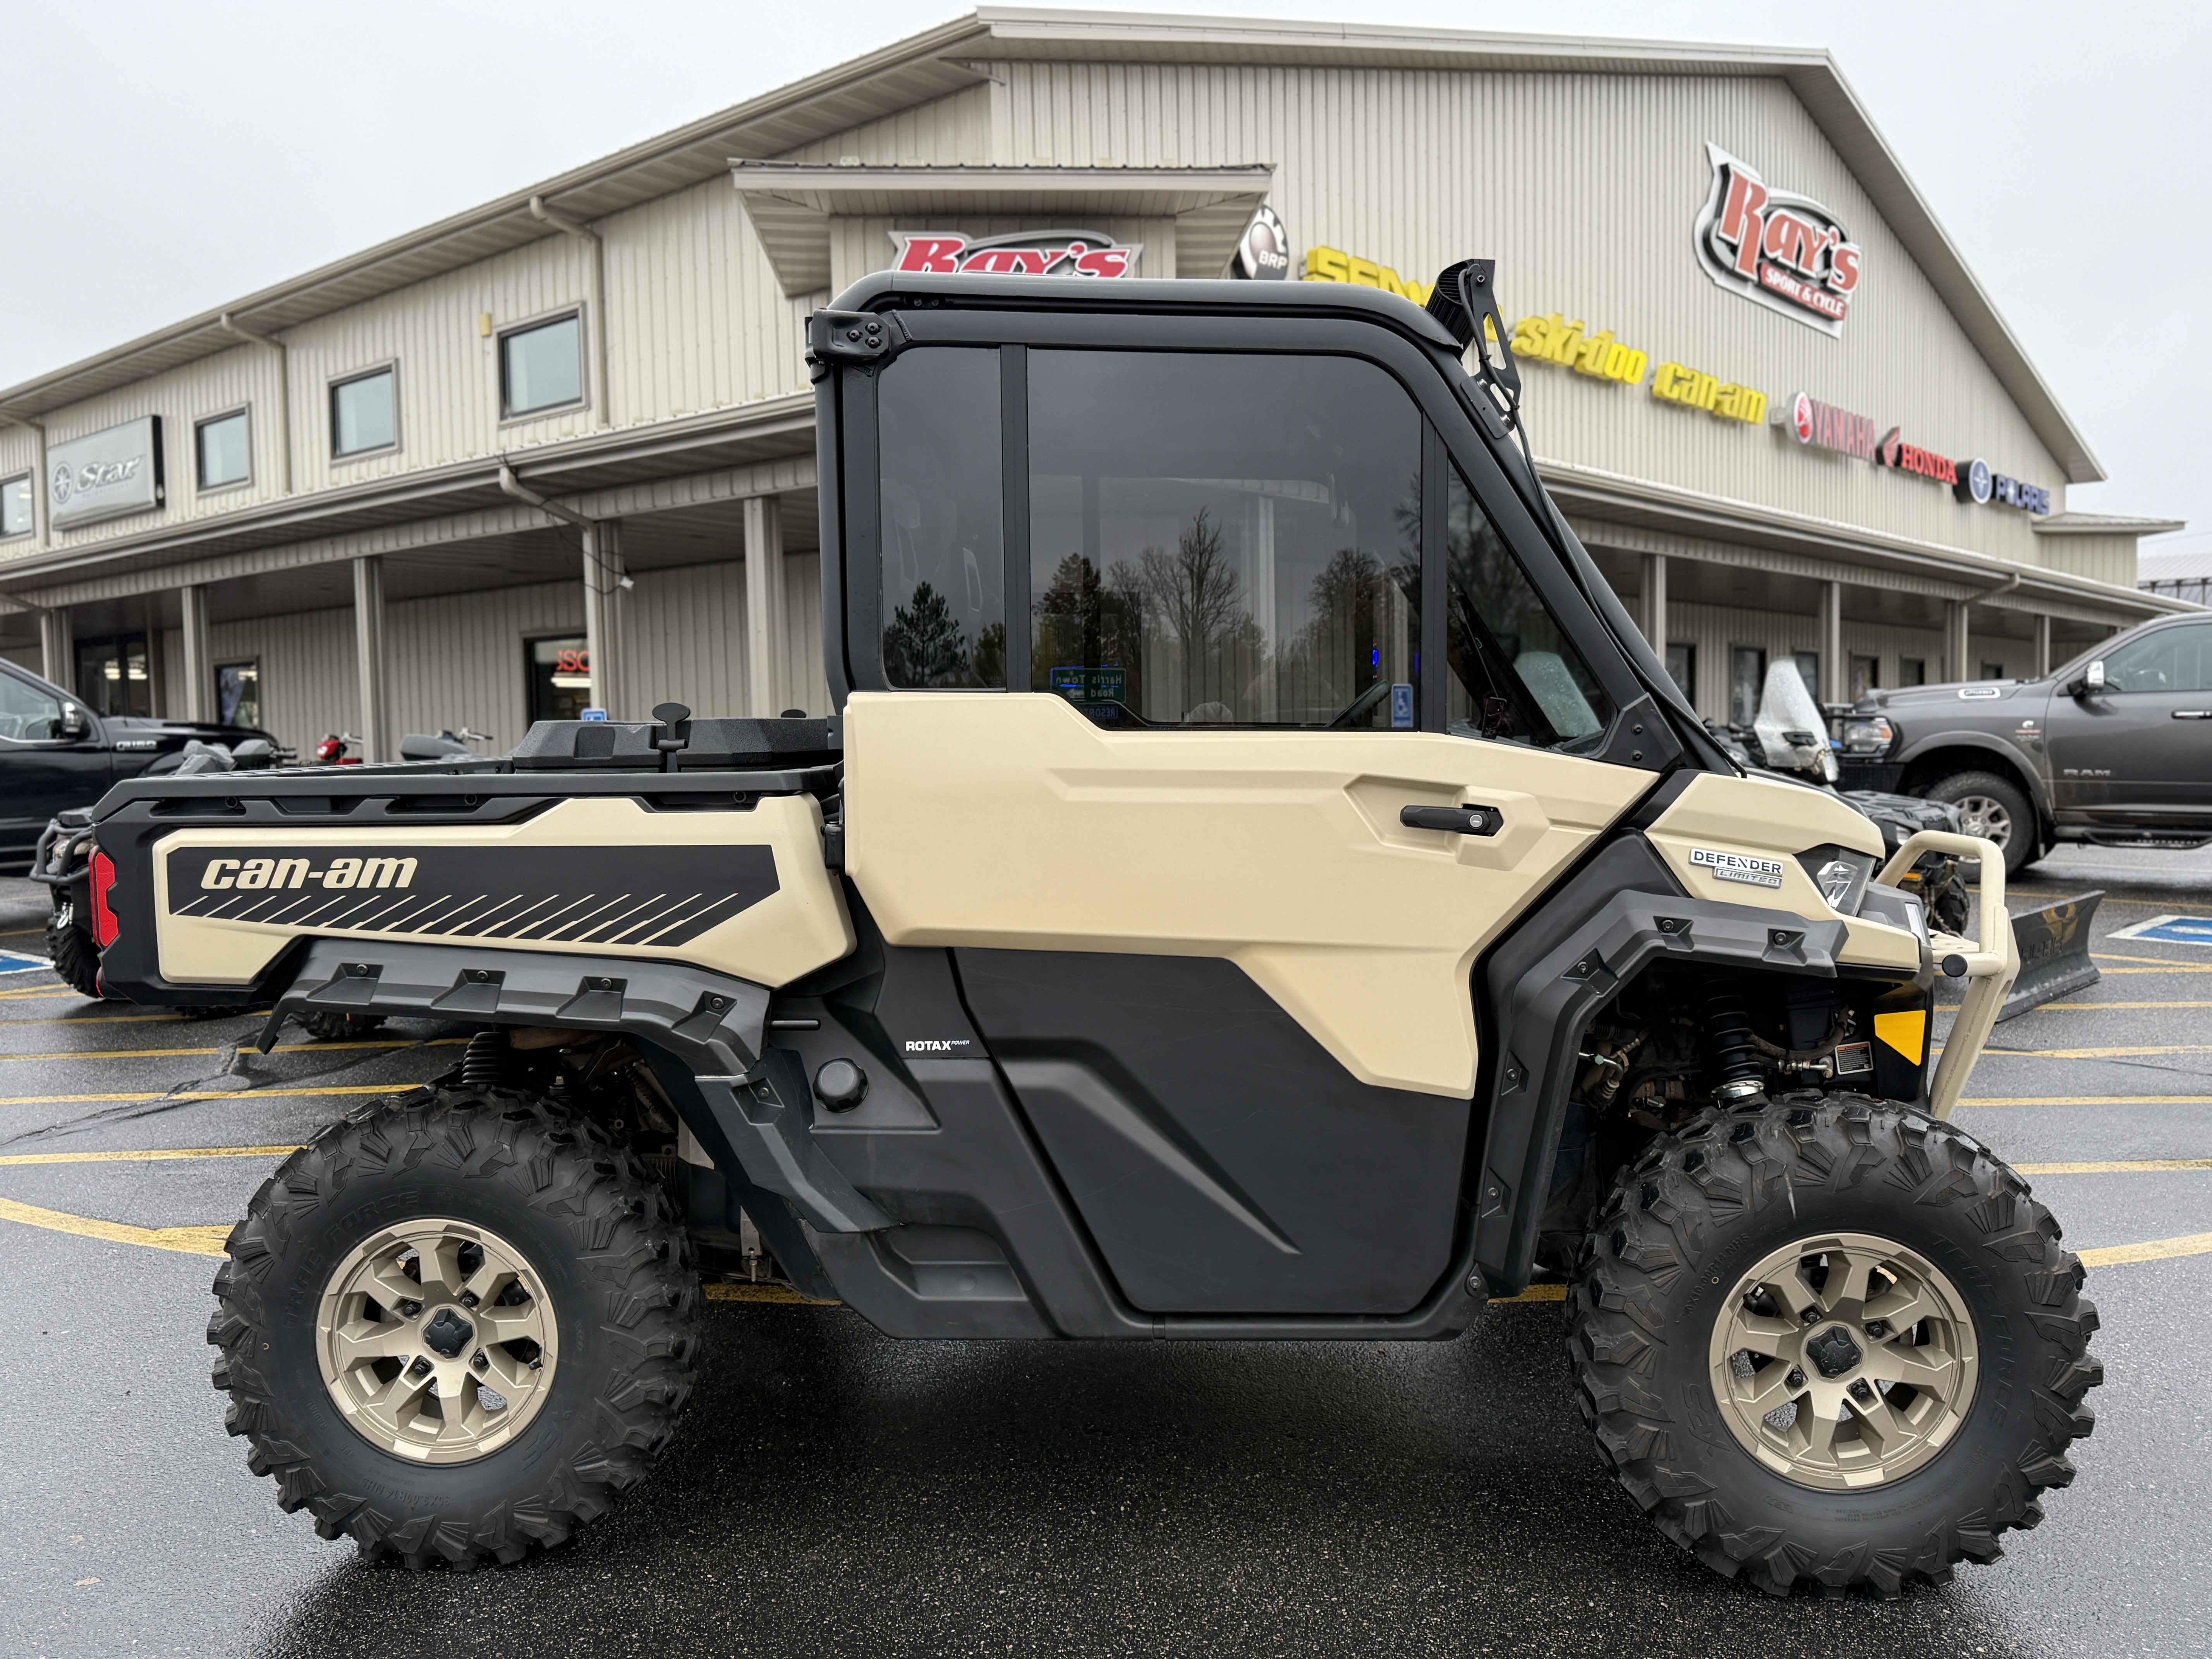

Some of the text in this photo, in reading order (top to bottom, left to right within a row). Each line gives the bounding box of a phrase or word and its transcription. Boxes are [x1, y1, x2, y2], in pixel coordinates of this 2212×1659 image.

[1718, 167, 1861, 292] Ray's
[1259, 250, 1288, 270] BRP
[1765, 268, 1845, 317] SPORT & CYCLE
[1813, 399, 1875, 461] YAMAHA
[75, 455, 146, 493] Star
[1901, 443, 1958, 485] HONDA
[1996, 474, 2050, 515] POLARIS
[200, 857, 418, 889] can-am
[1694, 851, 1781, 874] DEFENDER
[1719, 871, 1777, 884] LIMITED
[905, 1041, 951, 1051] ROTAX
